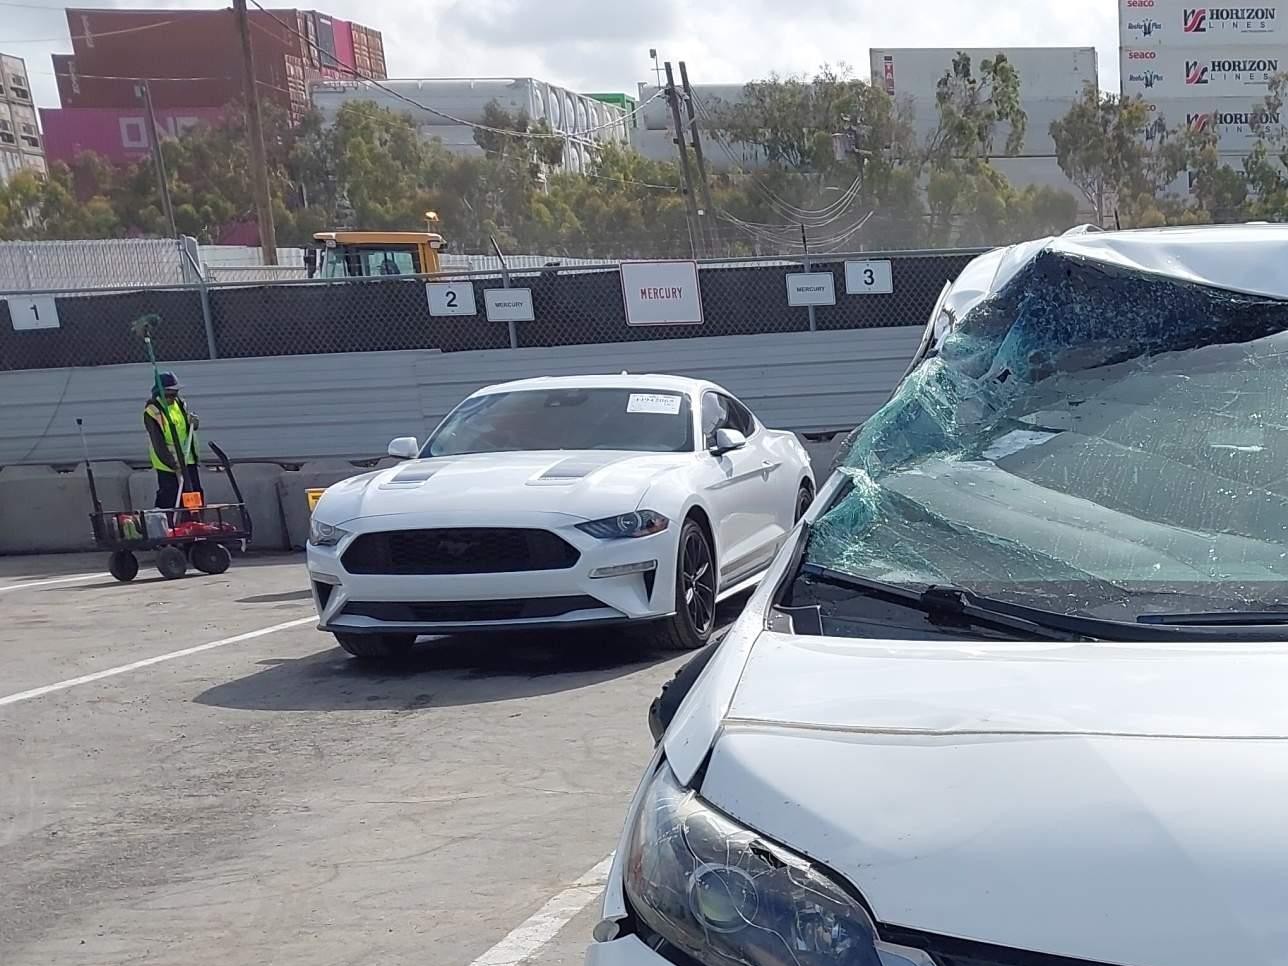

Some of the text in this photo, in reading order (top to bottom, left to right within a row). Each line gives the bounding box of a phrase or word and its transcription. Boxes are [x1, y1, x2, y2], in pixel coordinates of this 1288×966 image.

[1127, 0, 1154, 8] seaco
[1209, 8, 1276, 20] HORIZON
[1209, 21, 1266, 29] LINES
[1128, 51, 1156, 60] seaco
[1211, 60, 1278, 72] HORIZON
[1211, 73, 1269, 81] LINES
[863, 269, 875, 286] 3
[445, 291, 458, 308] 2
[640, 287, 682, 300] MERCURY
[30, 304, 40, 321] 1
